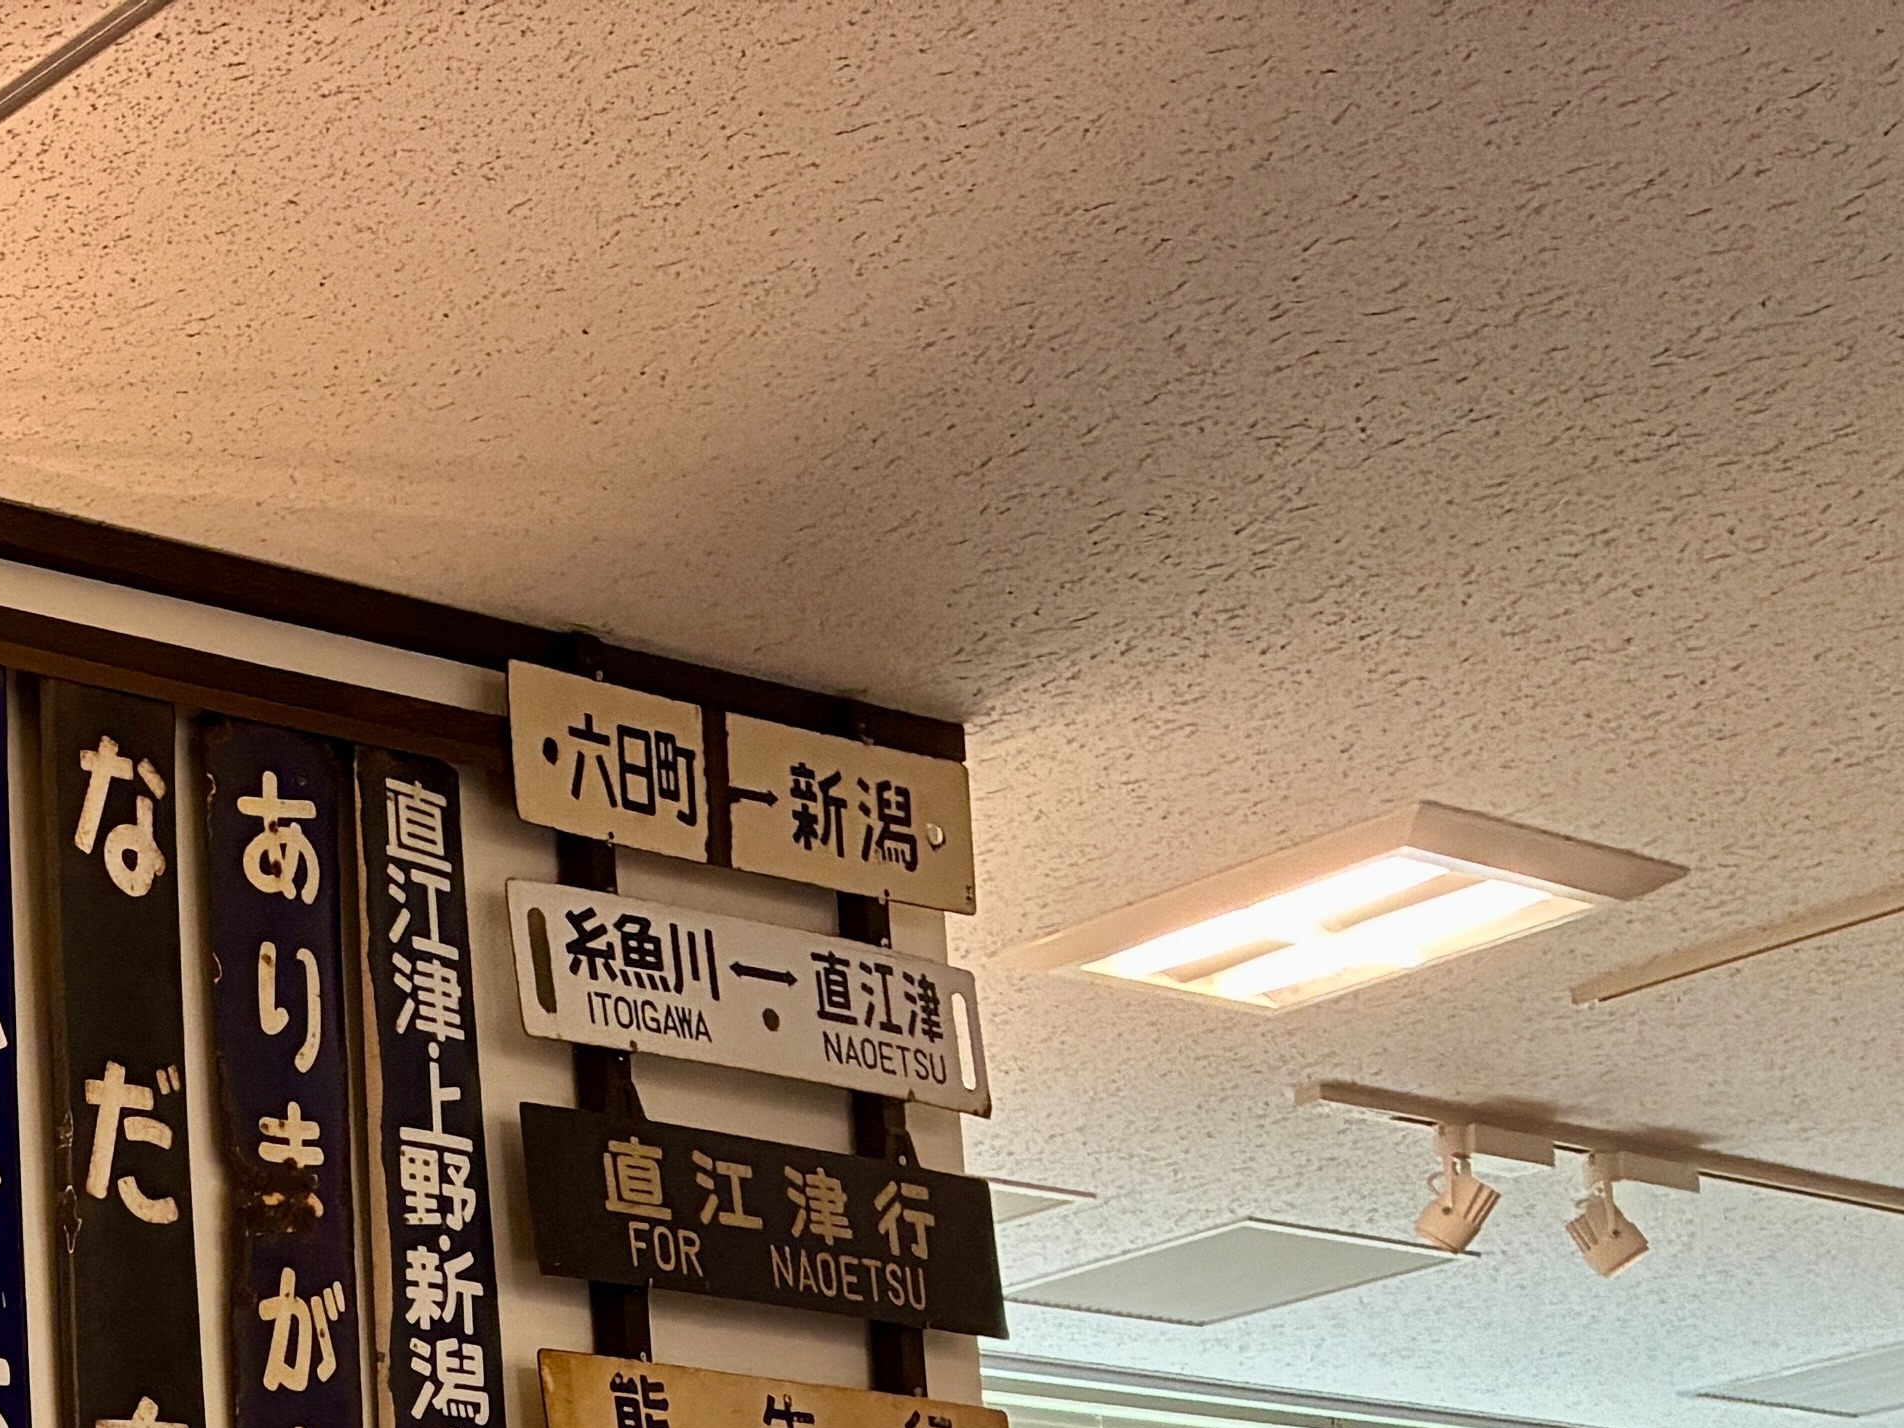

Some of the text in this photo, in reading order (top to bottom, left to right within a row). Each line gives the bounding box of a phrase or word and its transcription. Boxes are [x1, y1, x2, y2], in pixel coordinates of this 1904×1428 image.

[568, 713, 919, 872] 六日町 新潟
[565, 906, 944, 1045] 糸魚川 直江津
[587, 991, 948, 1086] ITOIGAWA NAOETSU
[603, 1136, 936, 1261] 直江津行
[627, 1221, 927, 1312] FOR NAOETSU
